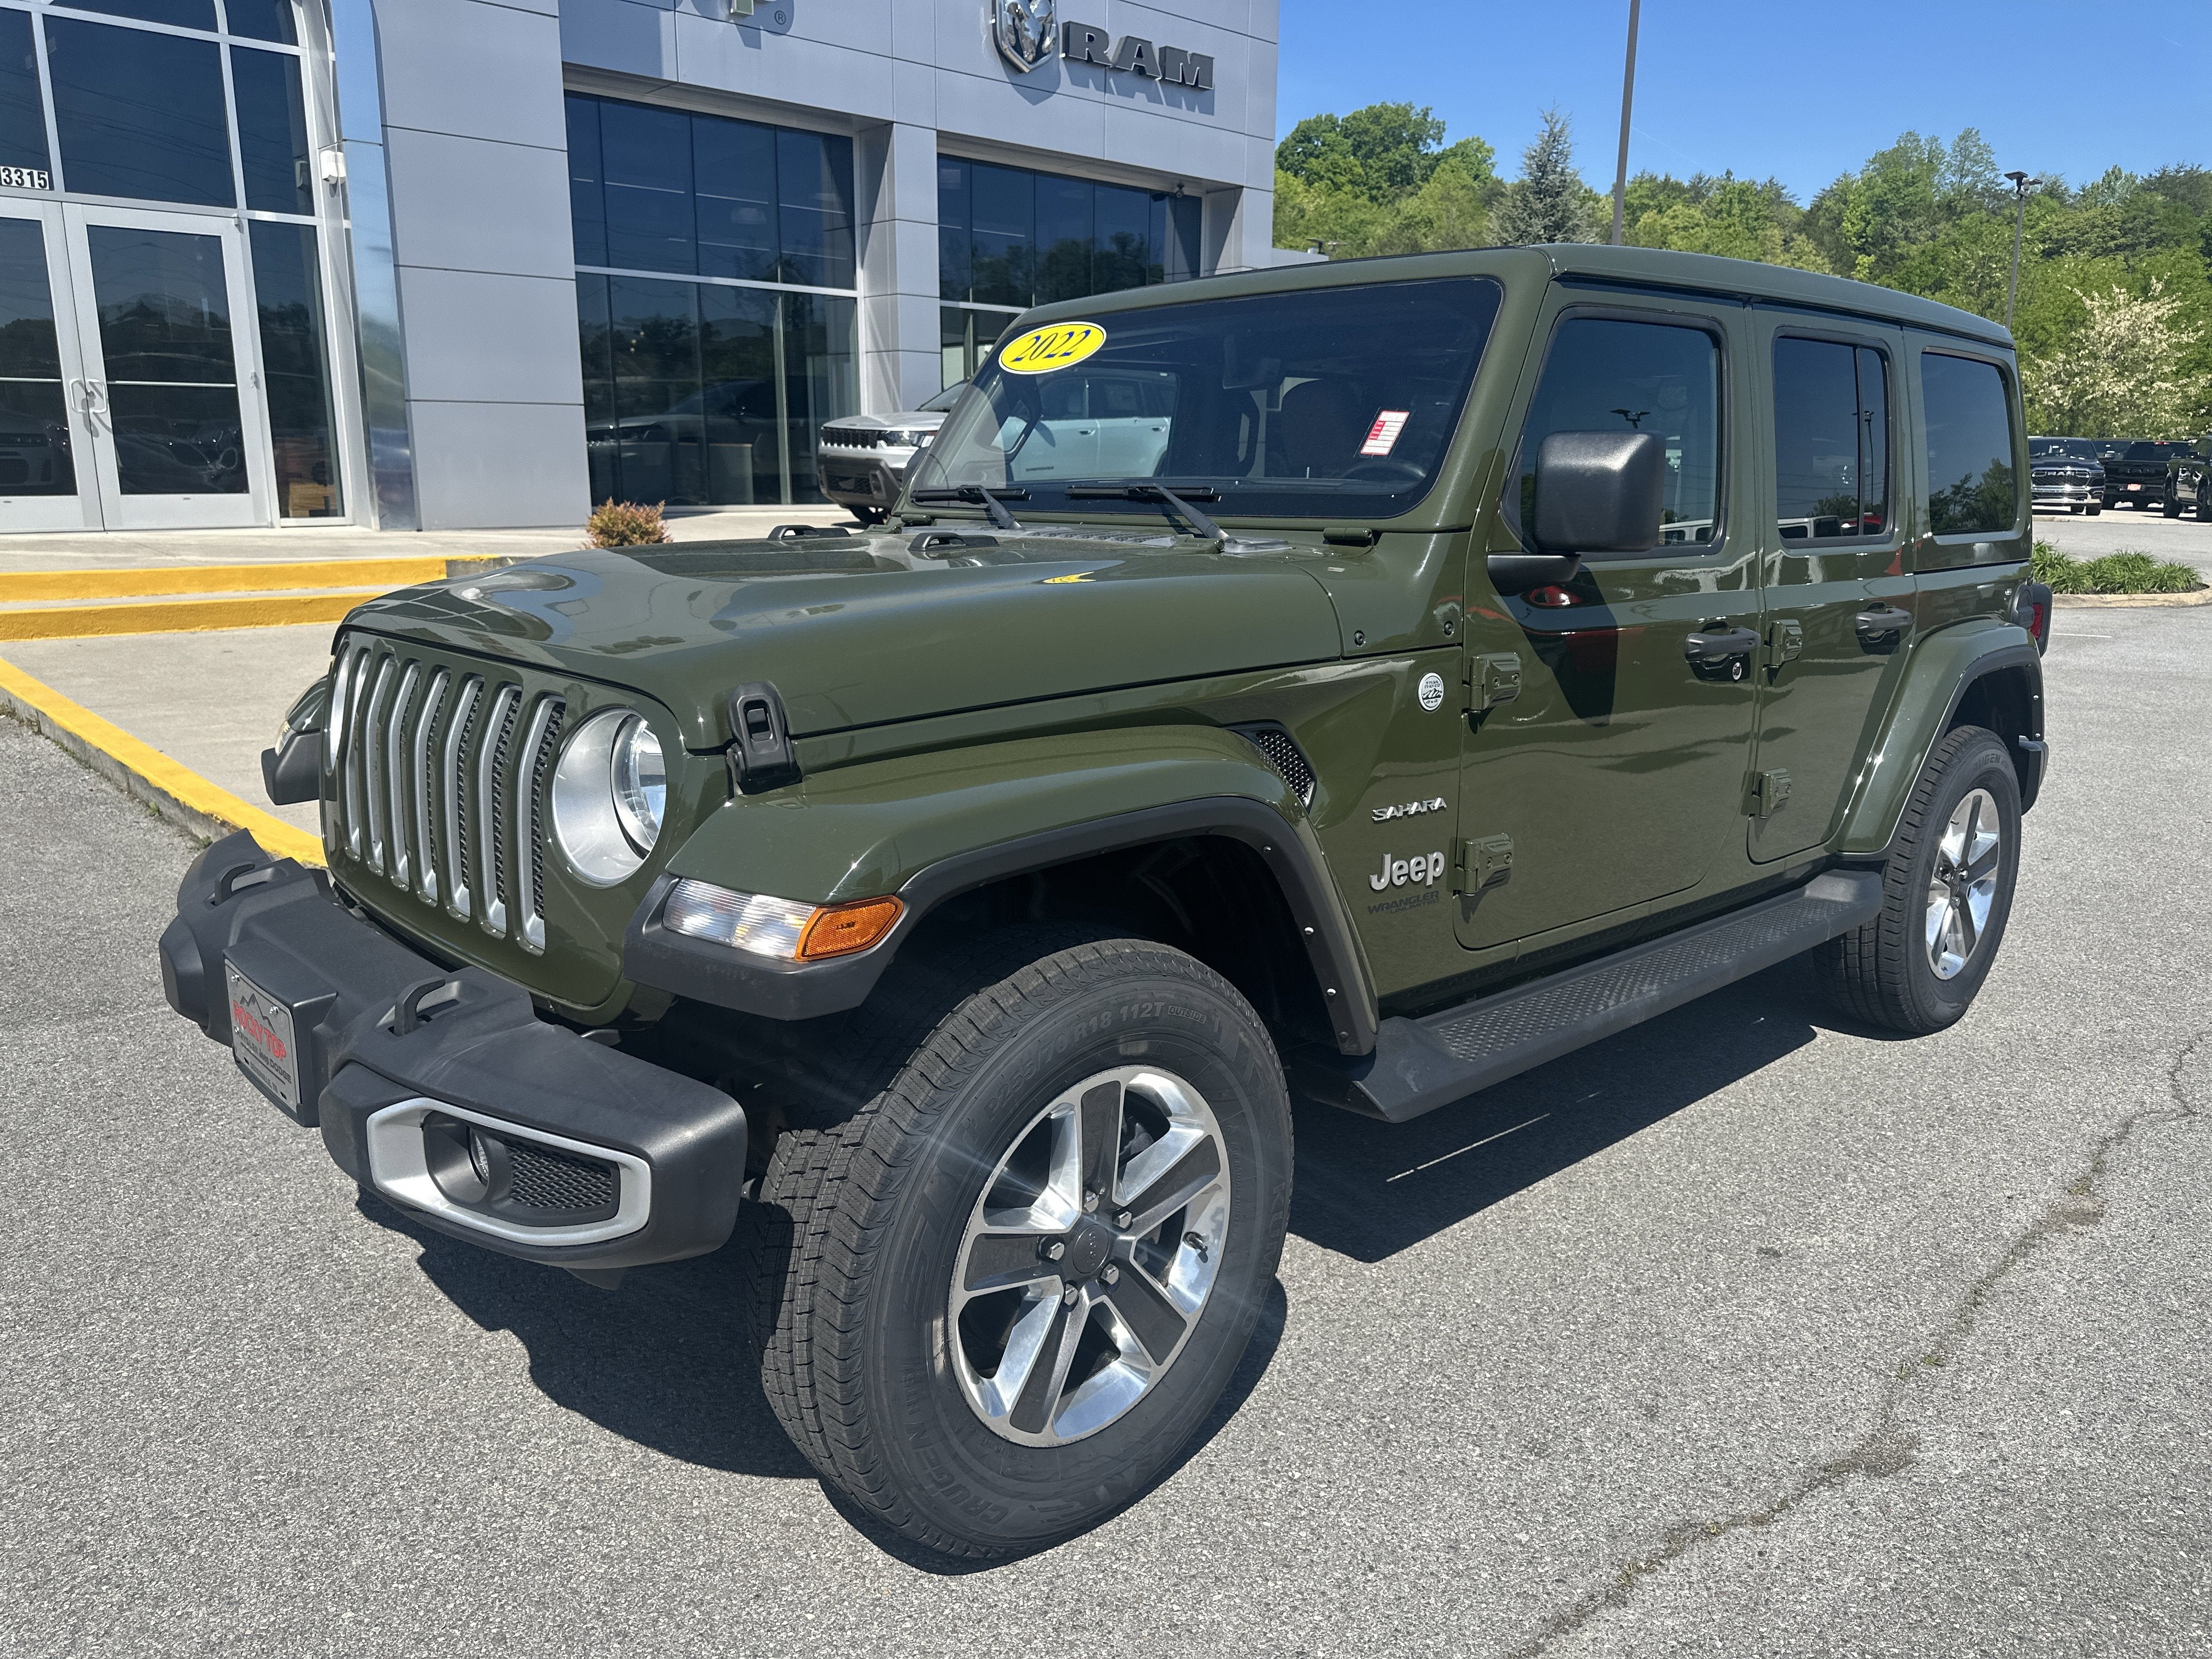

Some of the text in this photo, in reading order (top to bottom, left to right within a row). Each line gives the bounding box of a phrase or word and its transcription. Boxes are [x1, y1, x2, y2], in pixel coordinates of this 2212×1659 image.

[1063, 20, 1215, 89] RAM
[2, 167, 48, 189] 3315
[1010, 329, 1091, 363] 2022
[1372, 797, 1447, 821] SAHARA
[1369, 850, 1445, 891] Jeep
[1367, 890, 1440, 915] WRANGLER
[1390, 898, 1440, 915] UNLIMITED
[1075, 1011, 1112, 1041] R18
[1120, 1001, 1165, 1022] 112T
[1169, 1006, 1206, 1023] OUTSIDE
[263, 1026, 287, 1062] TOP
[269, 1058, 291, 1085] DODGE
[904, 1422, 1009, 1523] CRUGEN
